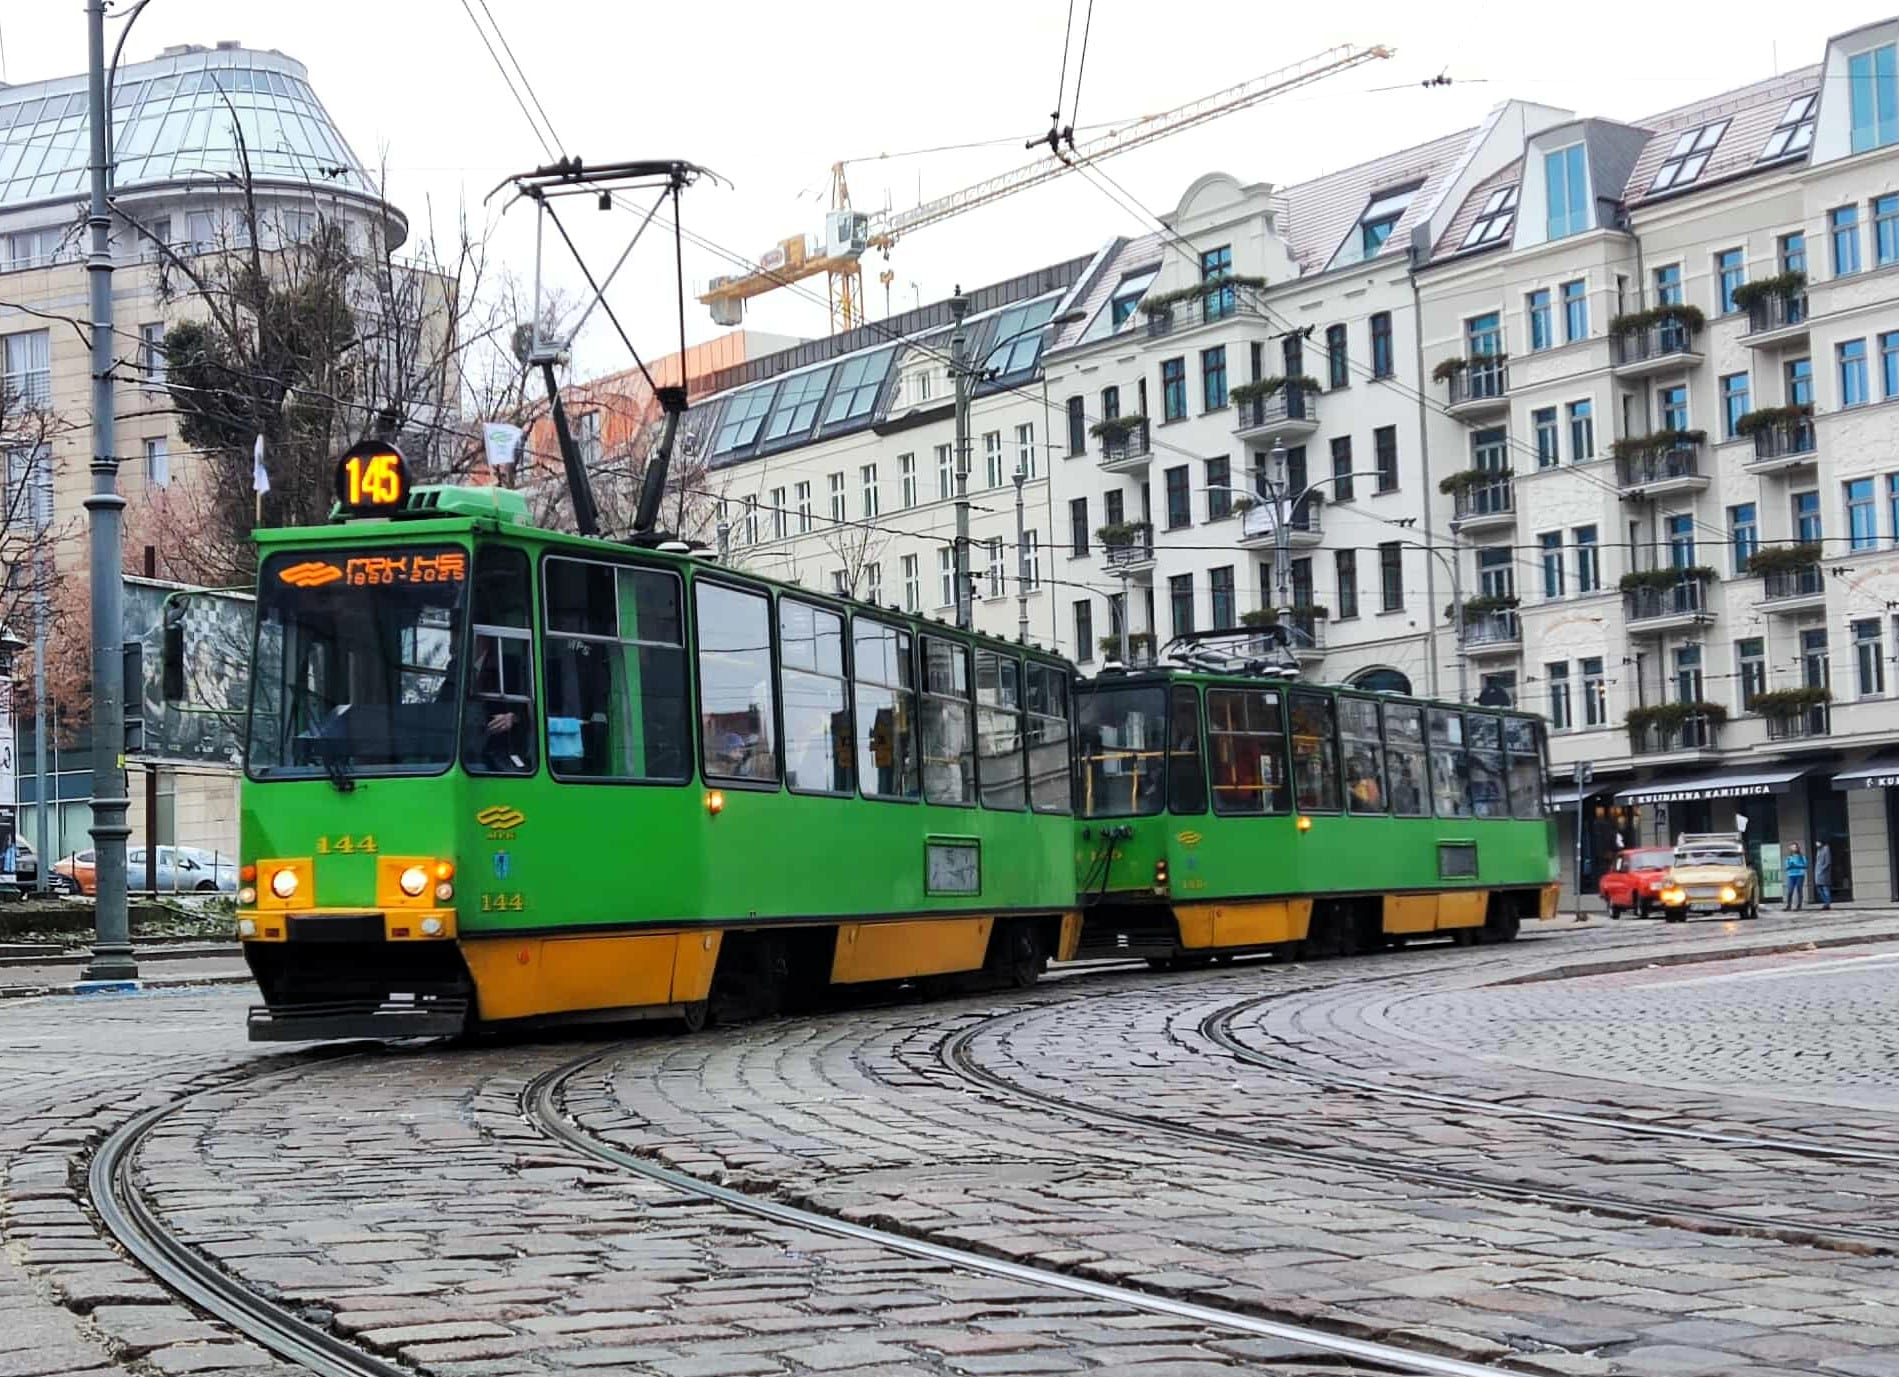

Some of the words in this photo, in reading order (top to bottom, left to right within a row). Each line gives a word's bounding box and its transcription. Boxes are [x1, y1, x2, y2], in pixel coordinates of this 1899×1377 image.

[345, 455, 398, 504] 145
[315, 834, 378, 854] 144
[482, 894, 523, 911] 144
